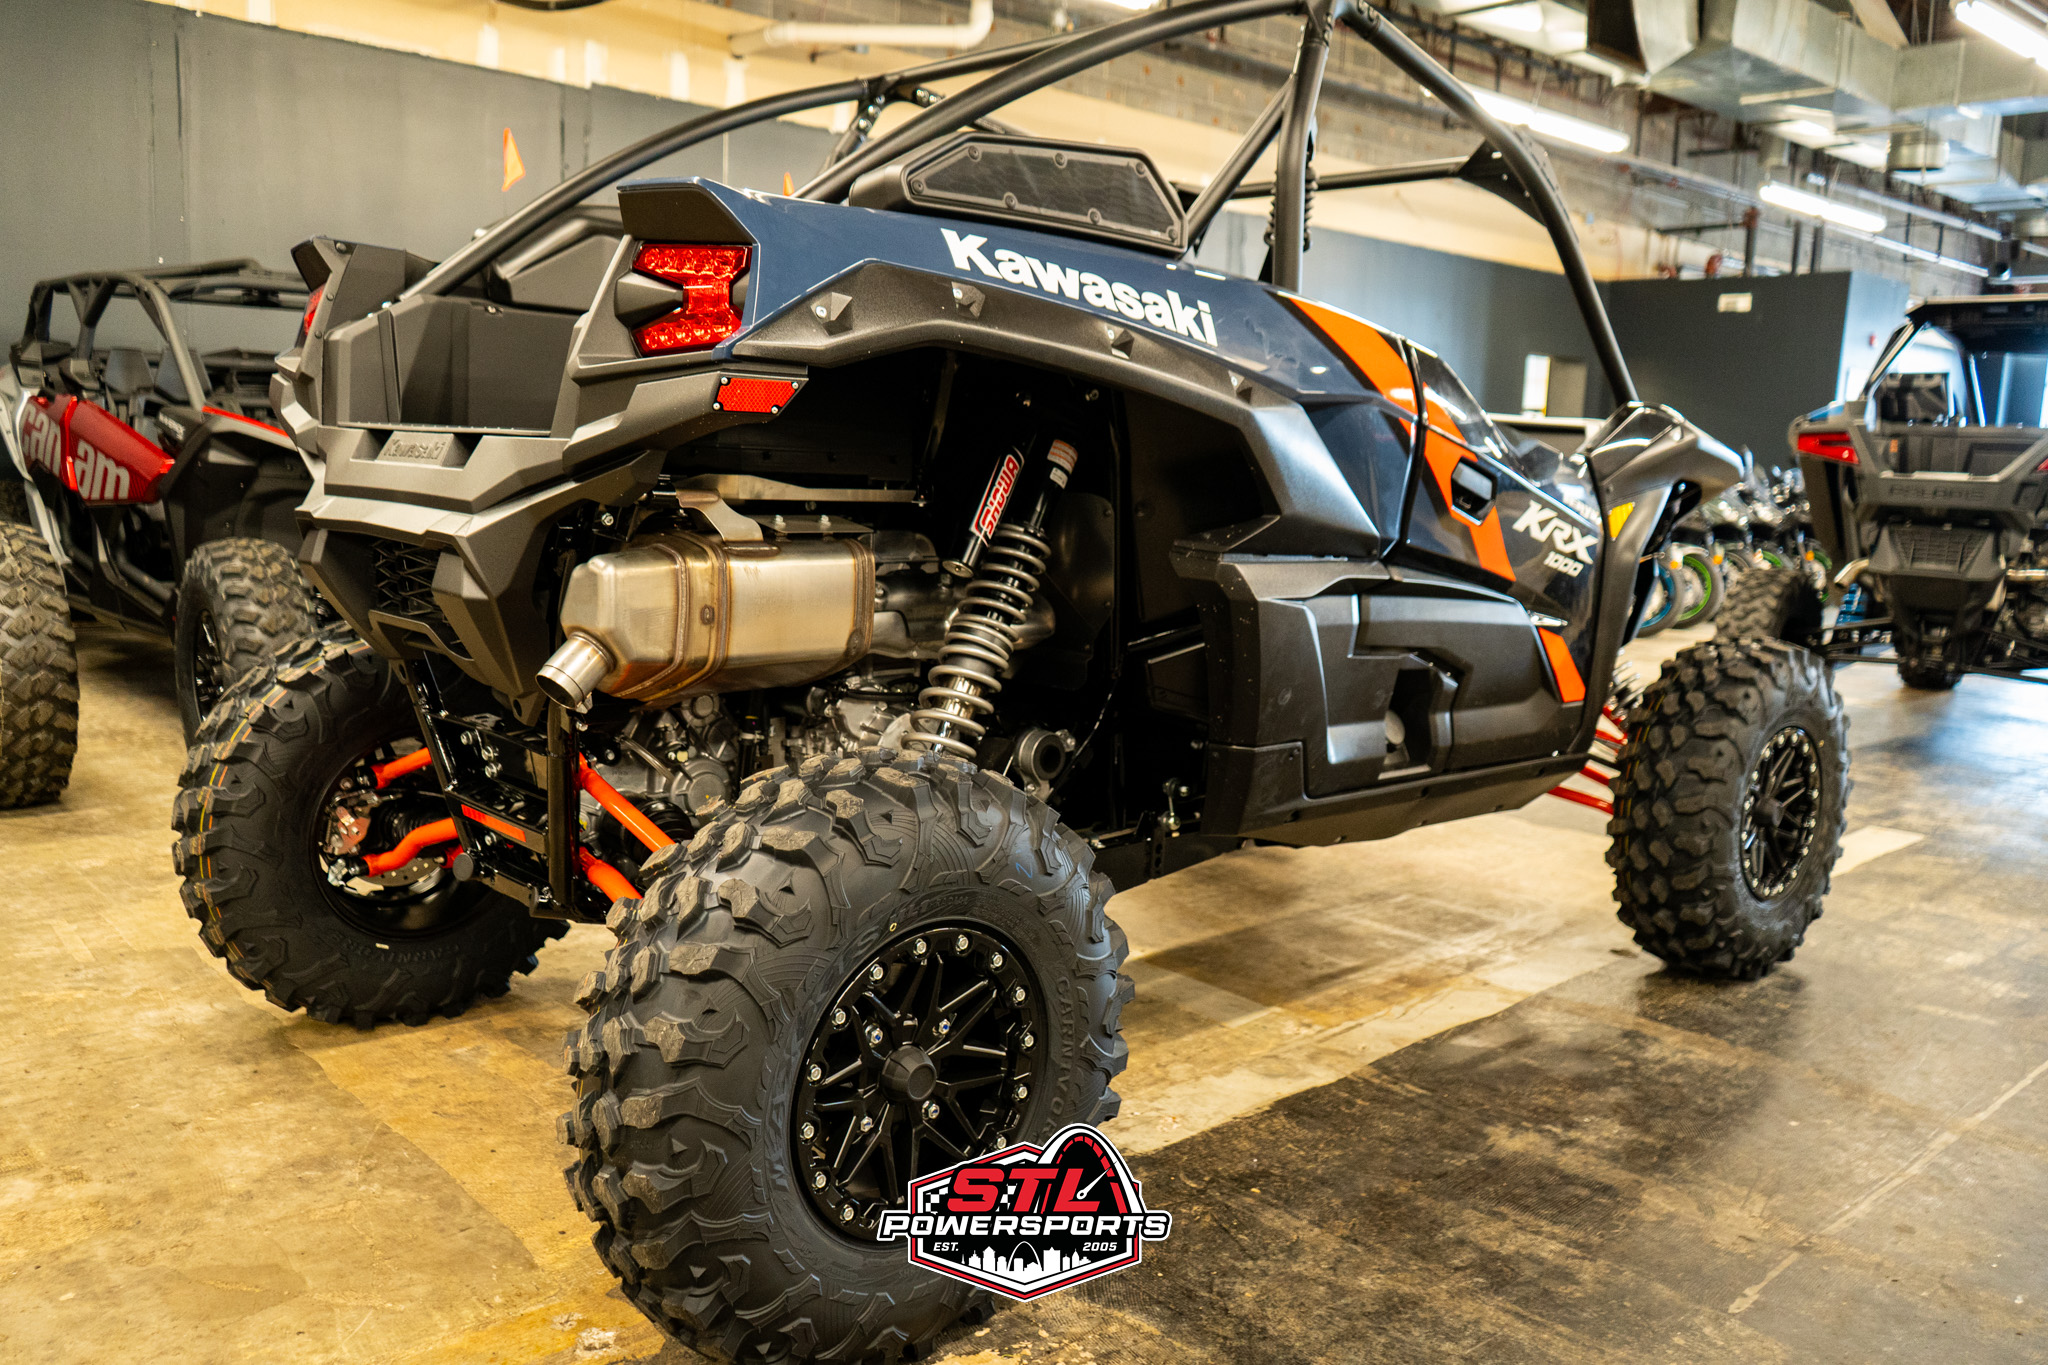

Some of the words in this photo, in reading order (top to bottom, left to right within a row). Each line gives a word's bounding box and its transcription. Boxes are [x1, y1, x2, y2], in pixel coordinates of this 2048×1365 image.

[940, 228, 1218, 347] Kawasaki
[979, 454, 1021, 540] SHOWA
[1512, 499, 1598, 565] KRX
[1543, 550, 1584, 578] 1000
